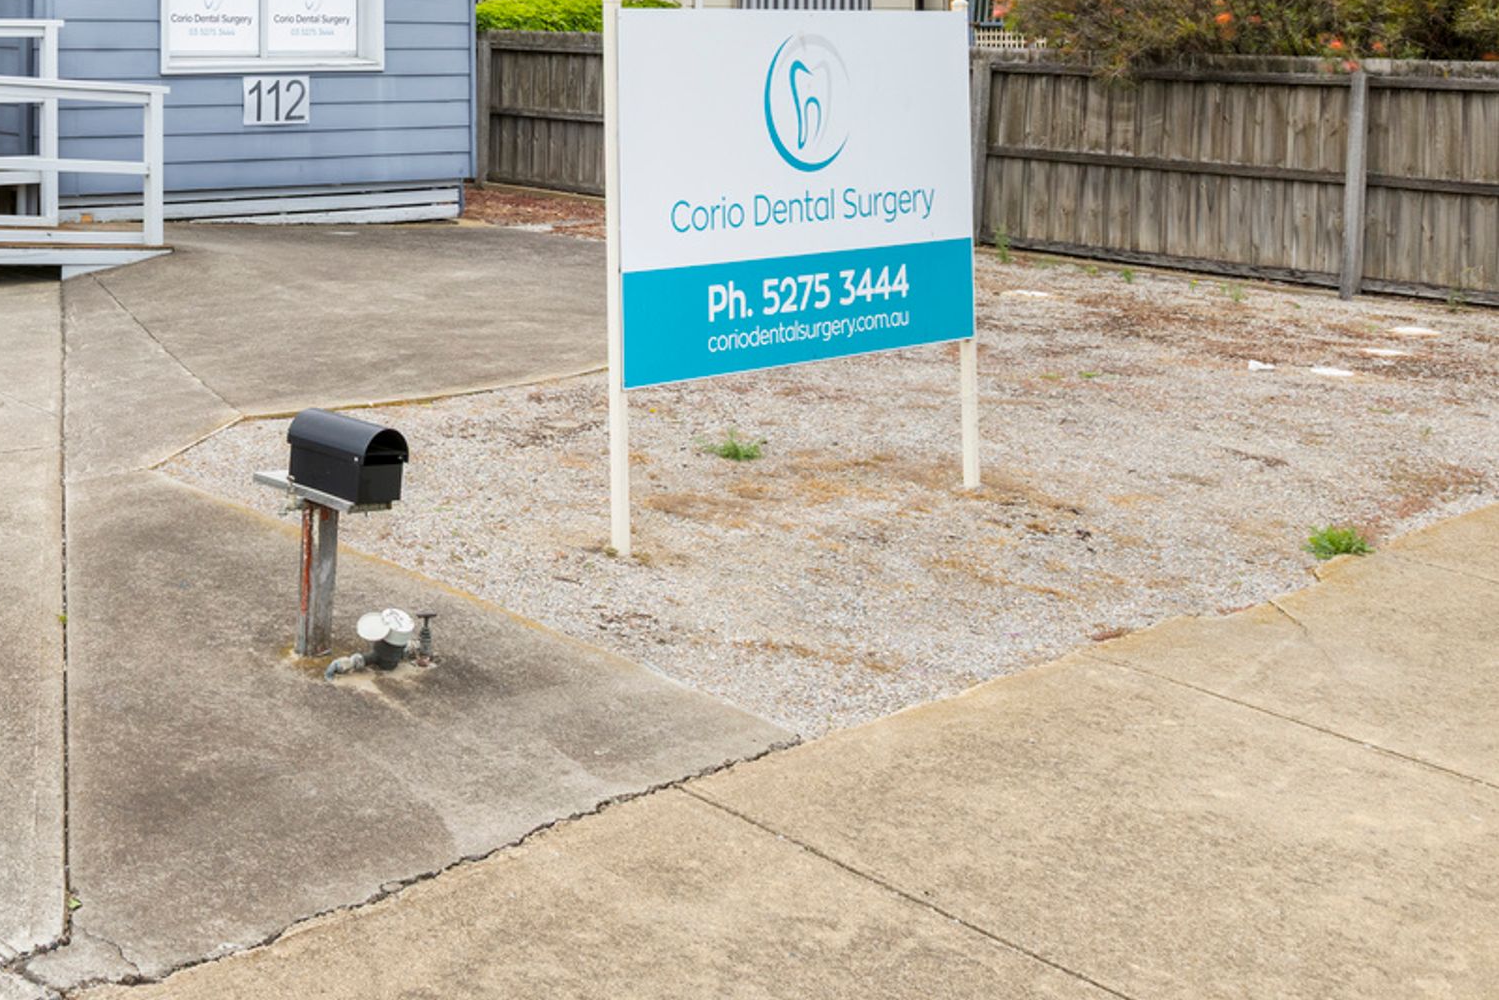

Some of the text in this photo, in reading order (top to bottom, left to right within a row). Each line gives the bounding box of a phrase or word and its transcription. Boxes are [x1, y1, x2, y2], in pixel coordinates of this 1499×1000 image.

[170, 13, 253, 25] Corio Dental Surgery
[273, 14, 350, 26] Corio Dental Surgery
[248, 79, 306, 122] 112
[670, 187, 935, 233] Corio Dental Surgery
[708, 263, 910, 323] Ph. 5275 3444
[708, 310, 910, 353] coriodentalsurgery.com.au
